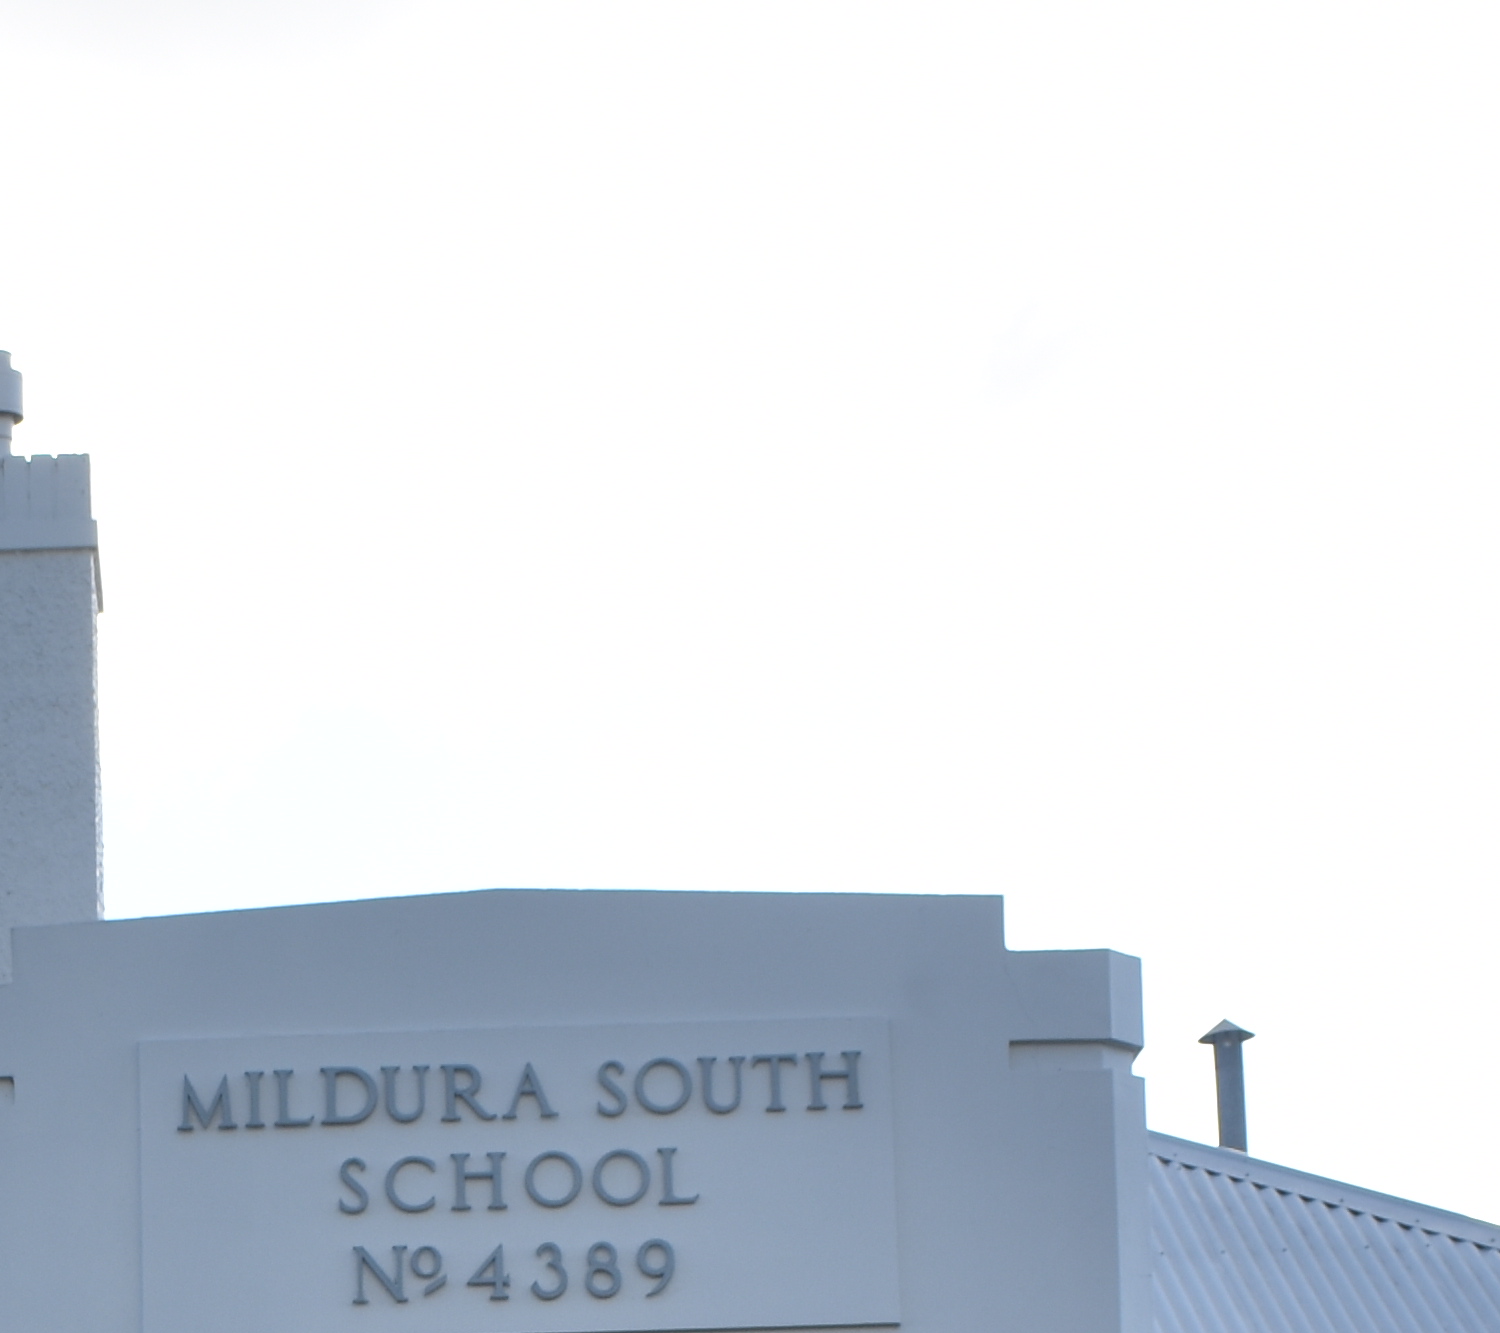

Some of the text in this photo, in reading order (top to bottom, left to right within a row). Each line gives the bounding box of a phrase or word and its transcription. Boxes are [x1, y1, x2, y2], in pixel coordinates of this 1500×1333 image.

[176, 1050, 864, 1132] MILDURA SOUTH
[338, 1147, 700, 1215] SCHOOL
